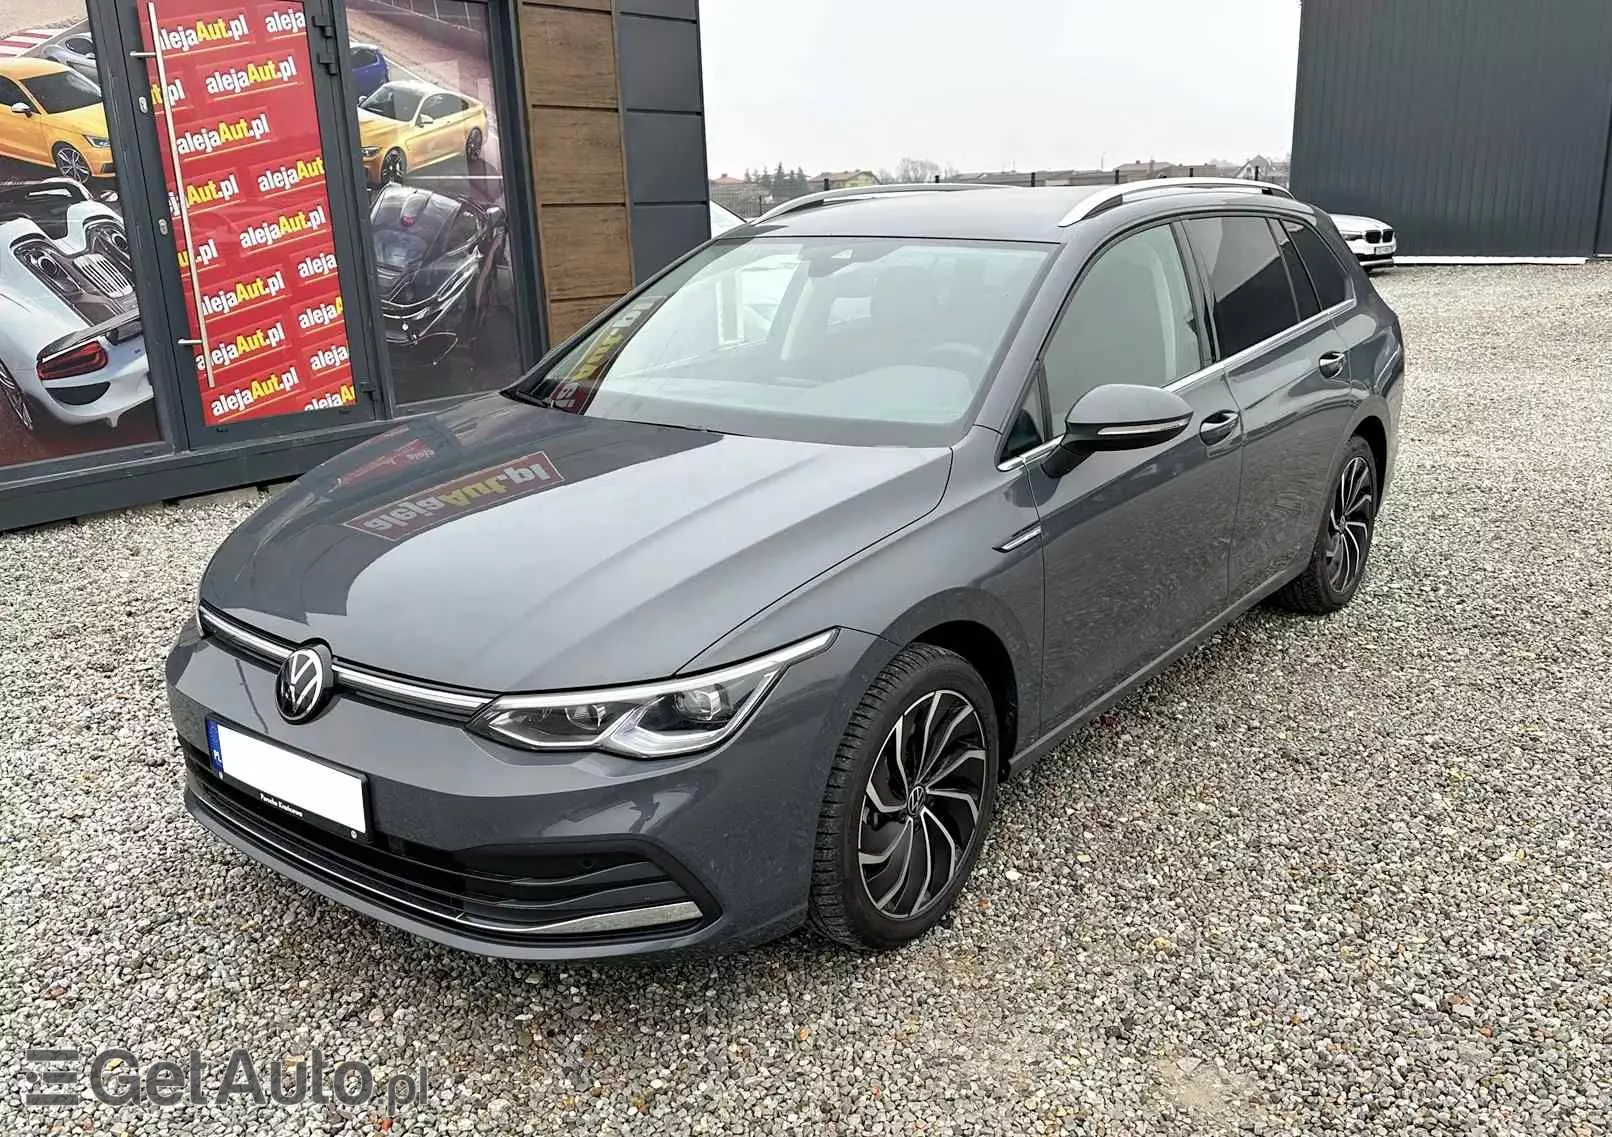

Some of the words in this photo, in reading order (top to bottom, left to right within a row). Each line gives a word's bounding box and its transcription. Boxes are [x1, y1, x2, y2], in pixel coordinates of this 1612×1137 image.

[206, 56, 296, 94] alejaAut.pl
[176, 114, 269, 153] alejaAut.pl
[239, 206, 326, 249] alejaAut.pl
[177, 239, 219, 269] u.pl
[297, 253, 338, 279] aleja
[196, 322, 286, 371] aejaAut.pl
[211, 367, 300, 416] alejaAut.pl
